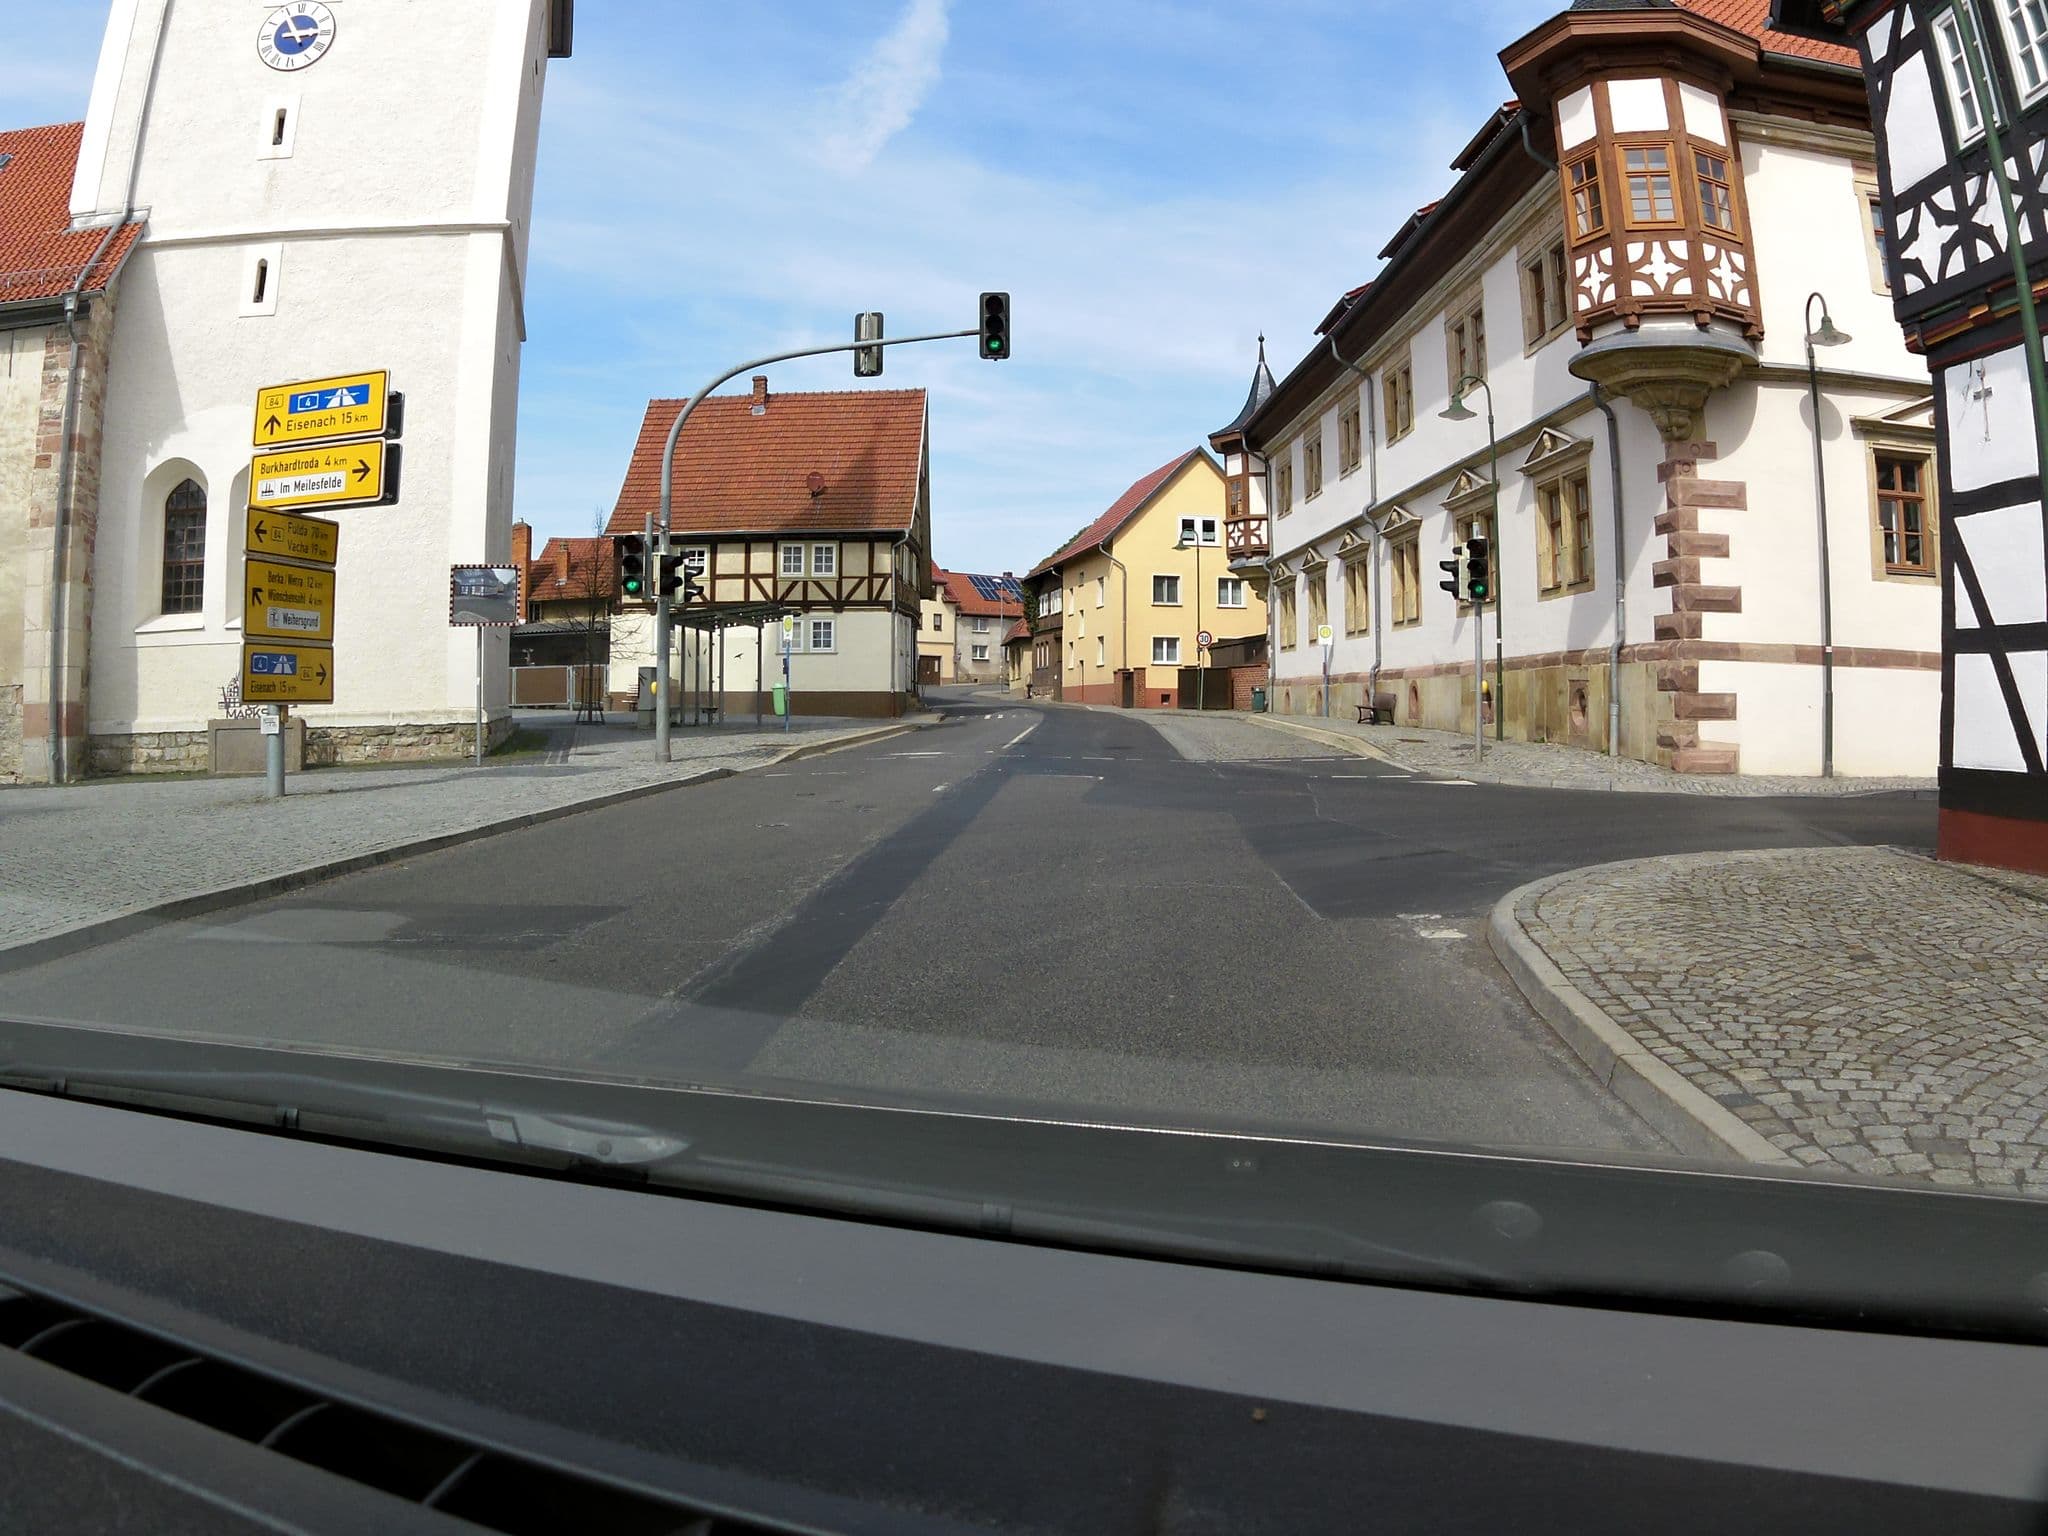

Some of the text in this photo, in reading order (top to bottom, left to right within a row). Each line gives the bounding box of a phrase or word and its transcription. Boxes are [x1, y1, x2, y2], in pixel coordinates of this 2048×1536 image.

[268, 398, 279, 407] 84
[305, 397, 311, 407] 4
[286, 412, 368, 432] Eisenach 15 km
[260, 456, 348, 474] Burkhardtroda 4 km
[280, 477, 342, 494] Im Meilesfelde
[288, 521, 308, 536] Fulda
[311, 526, 320, 538] 70
[288, 540, 308, 554] Vacha
[311, 543, 318, 554] 19
[306, 576, 314, 588] 12
[308, 594, 313, 604] 4
[250, 680, 276, 694] Eisenach
[280, 681, 287, 694] 15
